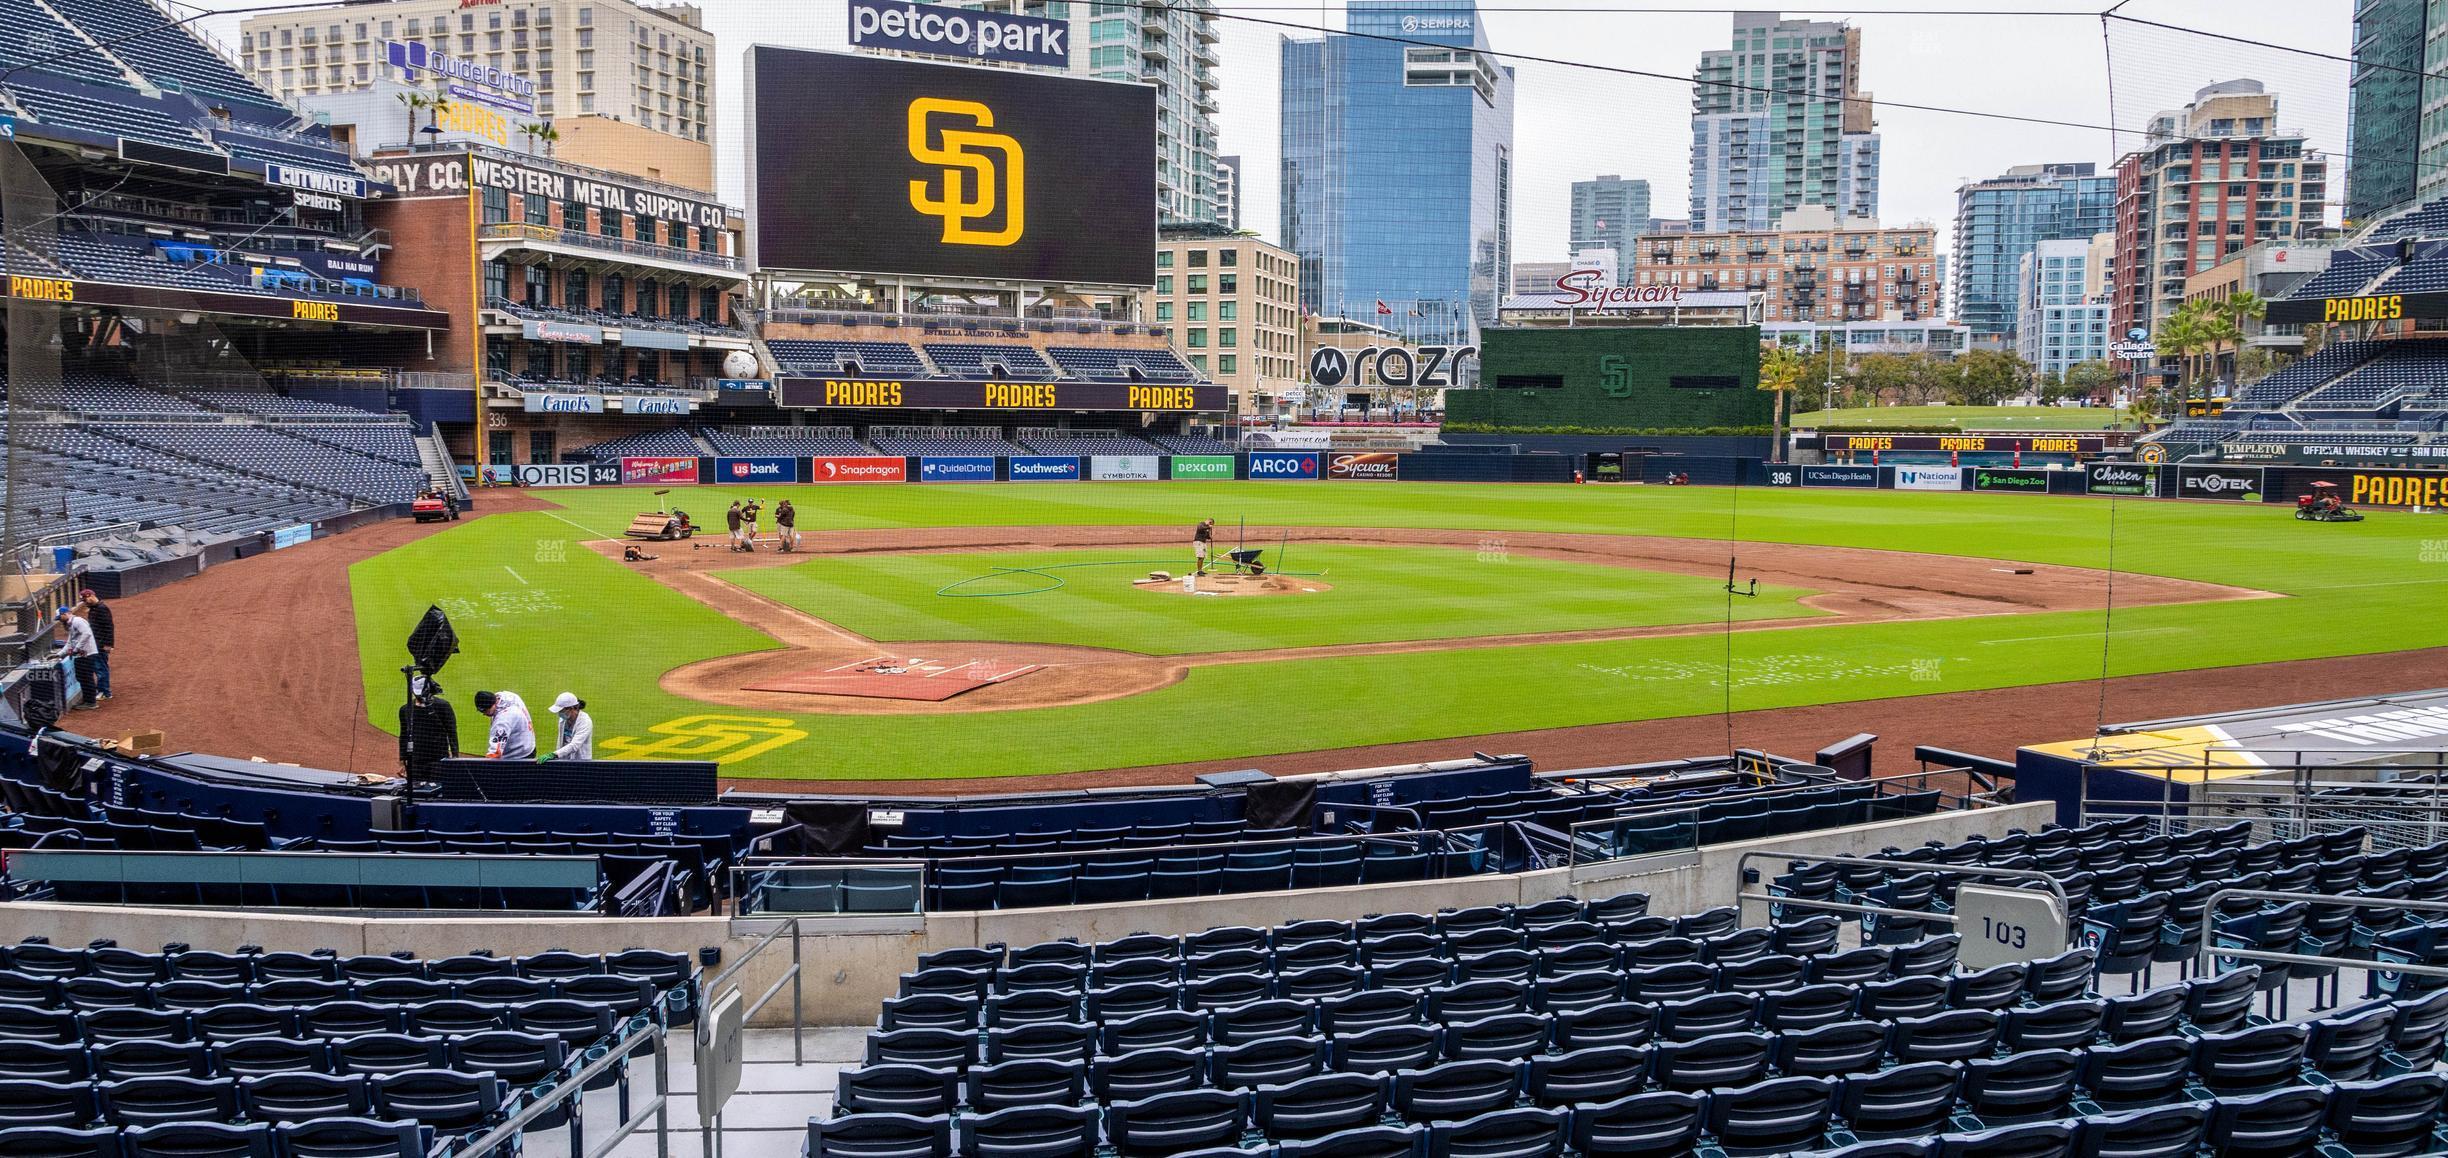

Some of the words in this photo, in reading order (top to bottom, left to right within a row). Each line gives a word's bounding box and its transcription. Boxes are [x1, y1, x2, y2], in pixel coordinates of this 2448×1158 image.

[854, 5, 969, 44] petco
[978, 20, 1065, 55] park
[1421, 19, 1470, 29] SEMPRA
[431, 50, 534, 97] QuidelOrtho
[437, 101, 507, 147] PADRES
[279, 166, 357, 196] CUTWATER
[429, 161, 469, 190] CO.
[294, 191, 342, 212] SPIRITS
[472, 158, 564, 198] WESTERN
[573, 179, 631, 212] METAL
[635, 192, 695, 222] SUPPLY
[700, 206, 725, 229] CO.
[327, 259, 344, 270] BALI
[345, 260, 357, 272] HAI
[11, 276, 74, 302] PADRES
[1554, 269, 1683, 314] Sycuan
[293, 300, 338, 321] PADRES
[2325, 295, 2402, 322] PADRES
[924, 329, 962, 337] ESTRELLA
[964, 330, 994, 338] JALISCO
[2117, 351, 2154, 360] Square
[1353, 346, 1477, 387] razr
[826, 380, 901, 406] PADRES
[986, 383, 1056, 408] PADRES
[1128, 386, 1194, 409] PADRES
[542, 394, 591, 412] Canel's
[637, 396, 679, 414] Canel's
[489, 412, 507, 428] 336
[1940, 438, 1985, 450] PADRES
[2032, 438, 2078, 451] PADRES
[2223, 444, 2287, 454] TEMPLETON
[2345, 446, 2389, 456] WHISKEY
[2412, 447, 2430, 457] SAN
[594, 468, 617, 482] 342
[734, 464, 749, 475] us
[750, 463, 780, 475] bank
[840, 464, 900, 477] Snapdragon
[938, 464, 991, 473] QuidelOrtho
[1014, 463, 1067, 474] Southwest
[1251, 459, 1299, 473] ARCO
[1333, 455, 1390, 477] Sycuan
[2093, 466, 2143, 481] Chosen
[523, 466, 587, 485] ORIS
[1772, 472, 1792, 485] 396
[1819, 472, 1831, 480] San
[1832, 473, 1850, 481] Diego
[1919, 472, 1957, 480] National
[2008, 477, 2029, 486] Diego
[2186, 474, 2254, 493] EVOTEK
[2351, 474, 2448, 507] PADRES
[1983, 916, 2026, 949] 103
